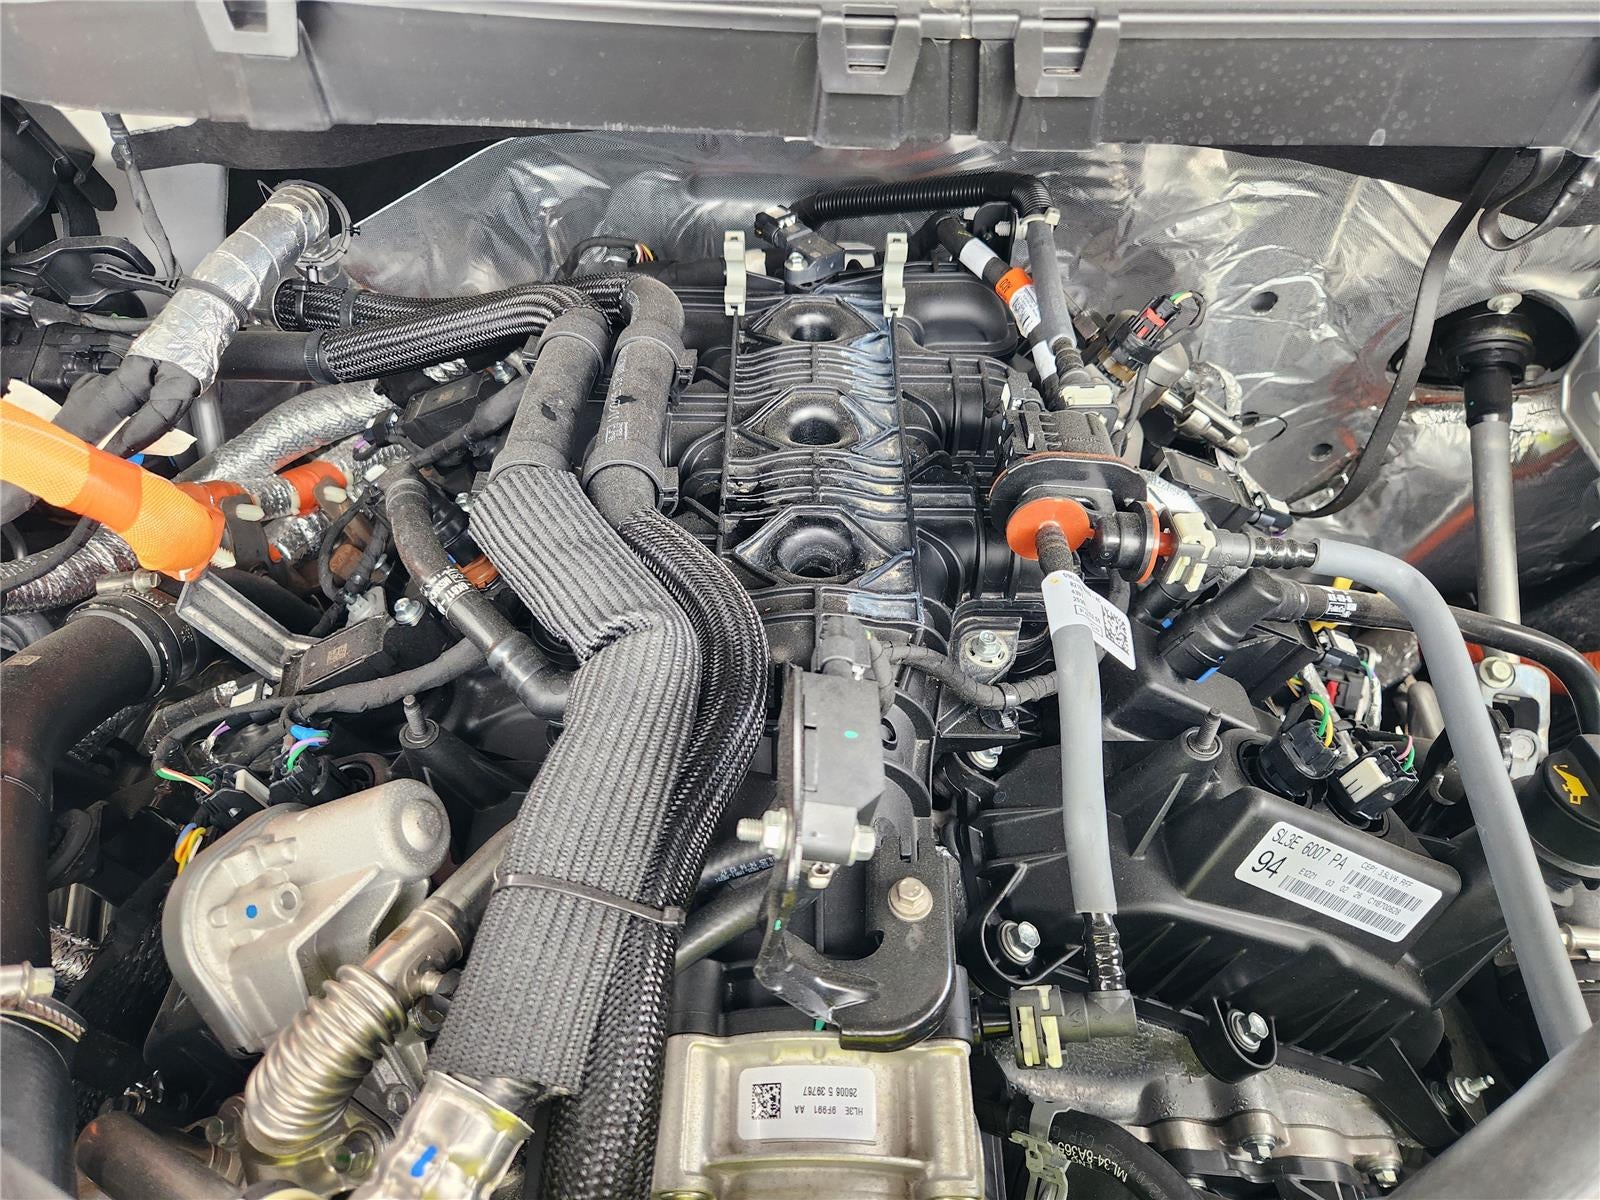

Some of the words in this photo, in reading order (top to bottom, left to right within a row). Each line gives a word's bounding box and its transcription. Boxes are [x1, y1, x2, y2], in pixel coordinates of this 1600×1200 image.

[1272, 828, 1303, 850] SL3E
[1301, 841, 1331, 861] 6007
[1327, 853, 1349, 871] PA
[1251, 850, 1287, 879] 94
[1325, 879, 1336, 888] 03
[1338, 885, 1350, 894] 02
[828, 1087, 834, 1097] 5
[794, 1104, 806, 1114] AA
[845, 1106, 863, 1116] HL3E
[1057, 1141, 1128, 1184] ML34-8A365
